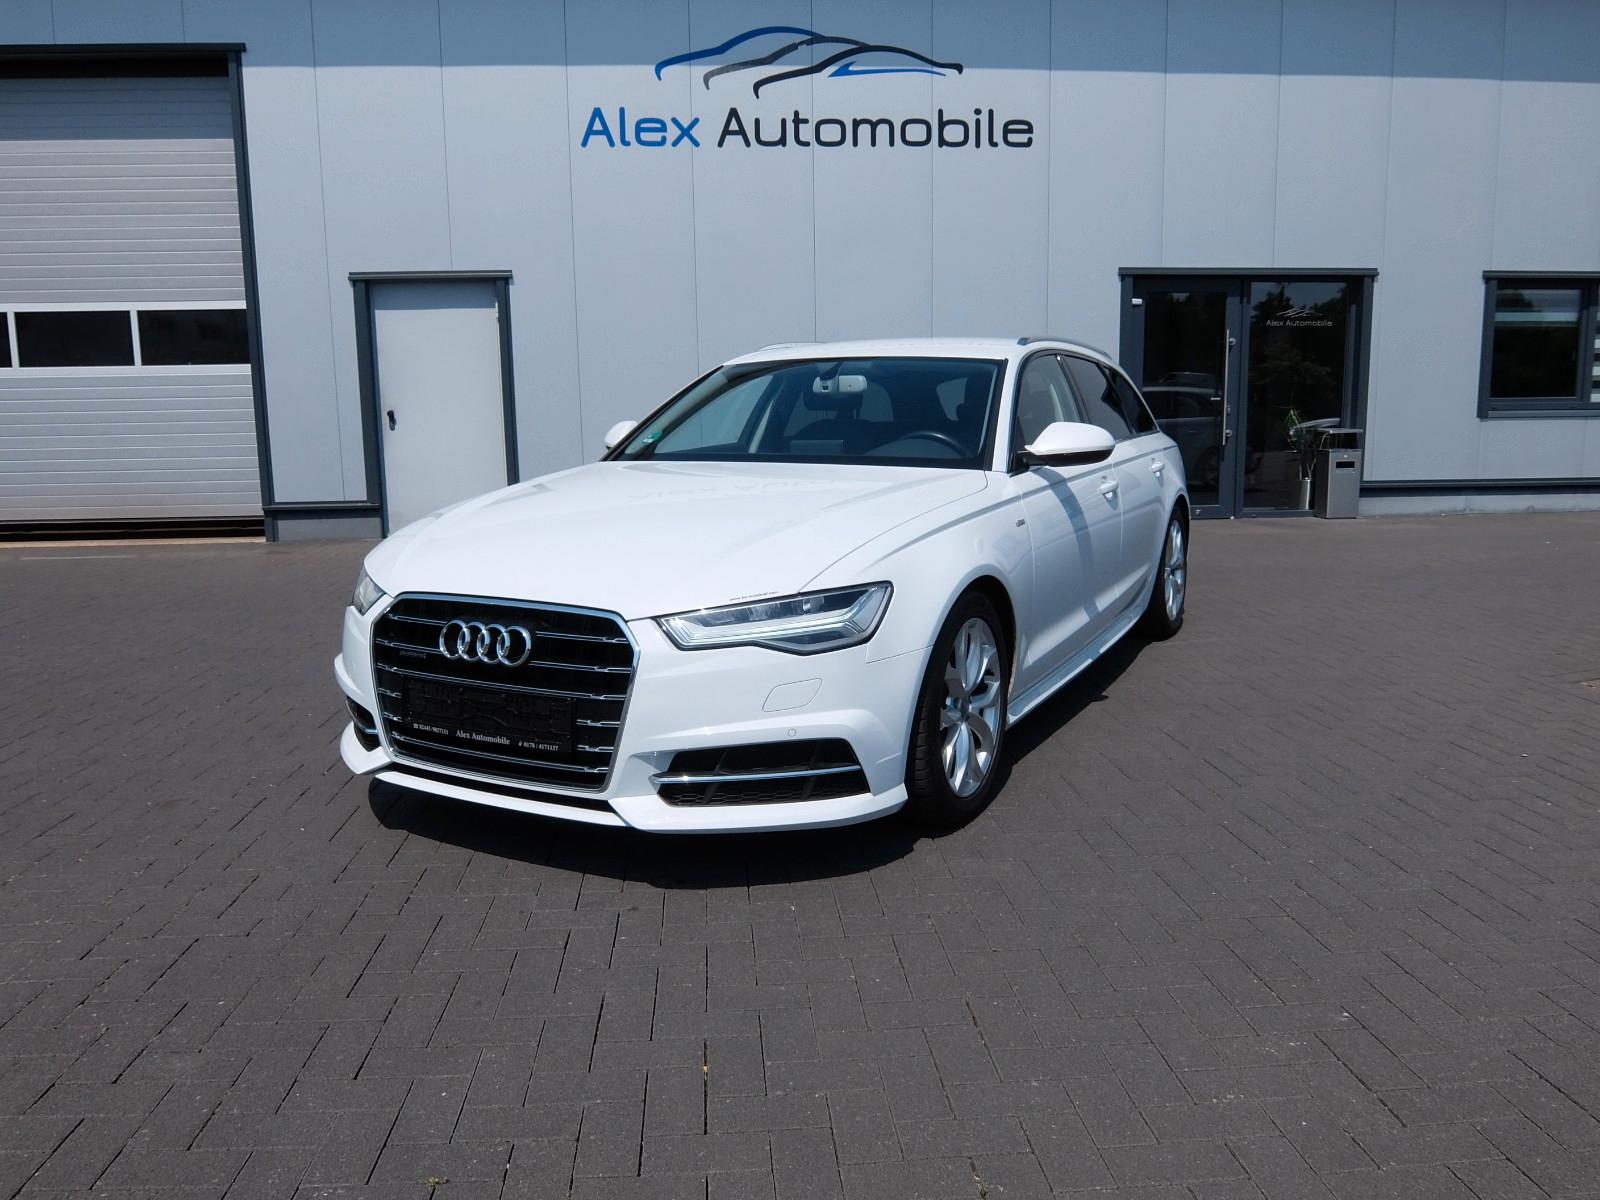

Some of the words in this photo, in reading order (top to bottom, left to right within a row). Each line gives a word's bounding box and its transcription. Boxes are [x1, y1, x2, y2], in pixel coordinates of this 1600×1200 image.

[580, 106, 700, 148] Alex
[717, 107, 1034, 149] Automobile
[1265, 319, 1285, 327] Alex
[1285, 319, 1333, 327] Automobile
[456, 730, 470, 739] Alex
[472, 732, 511, 745] Automobile
